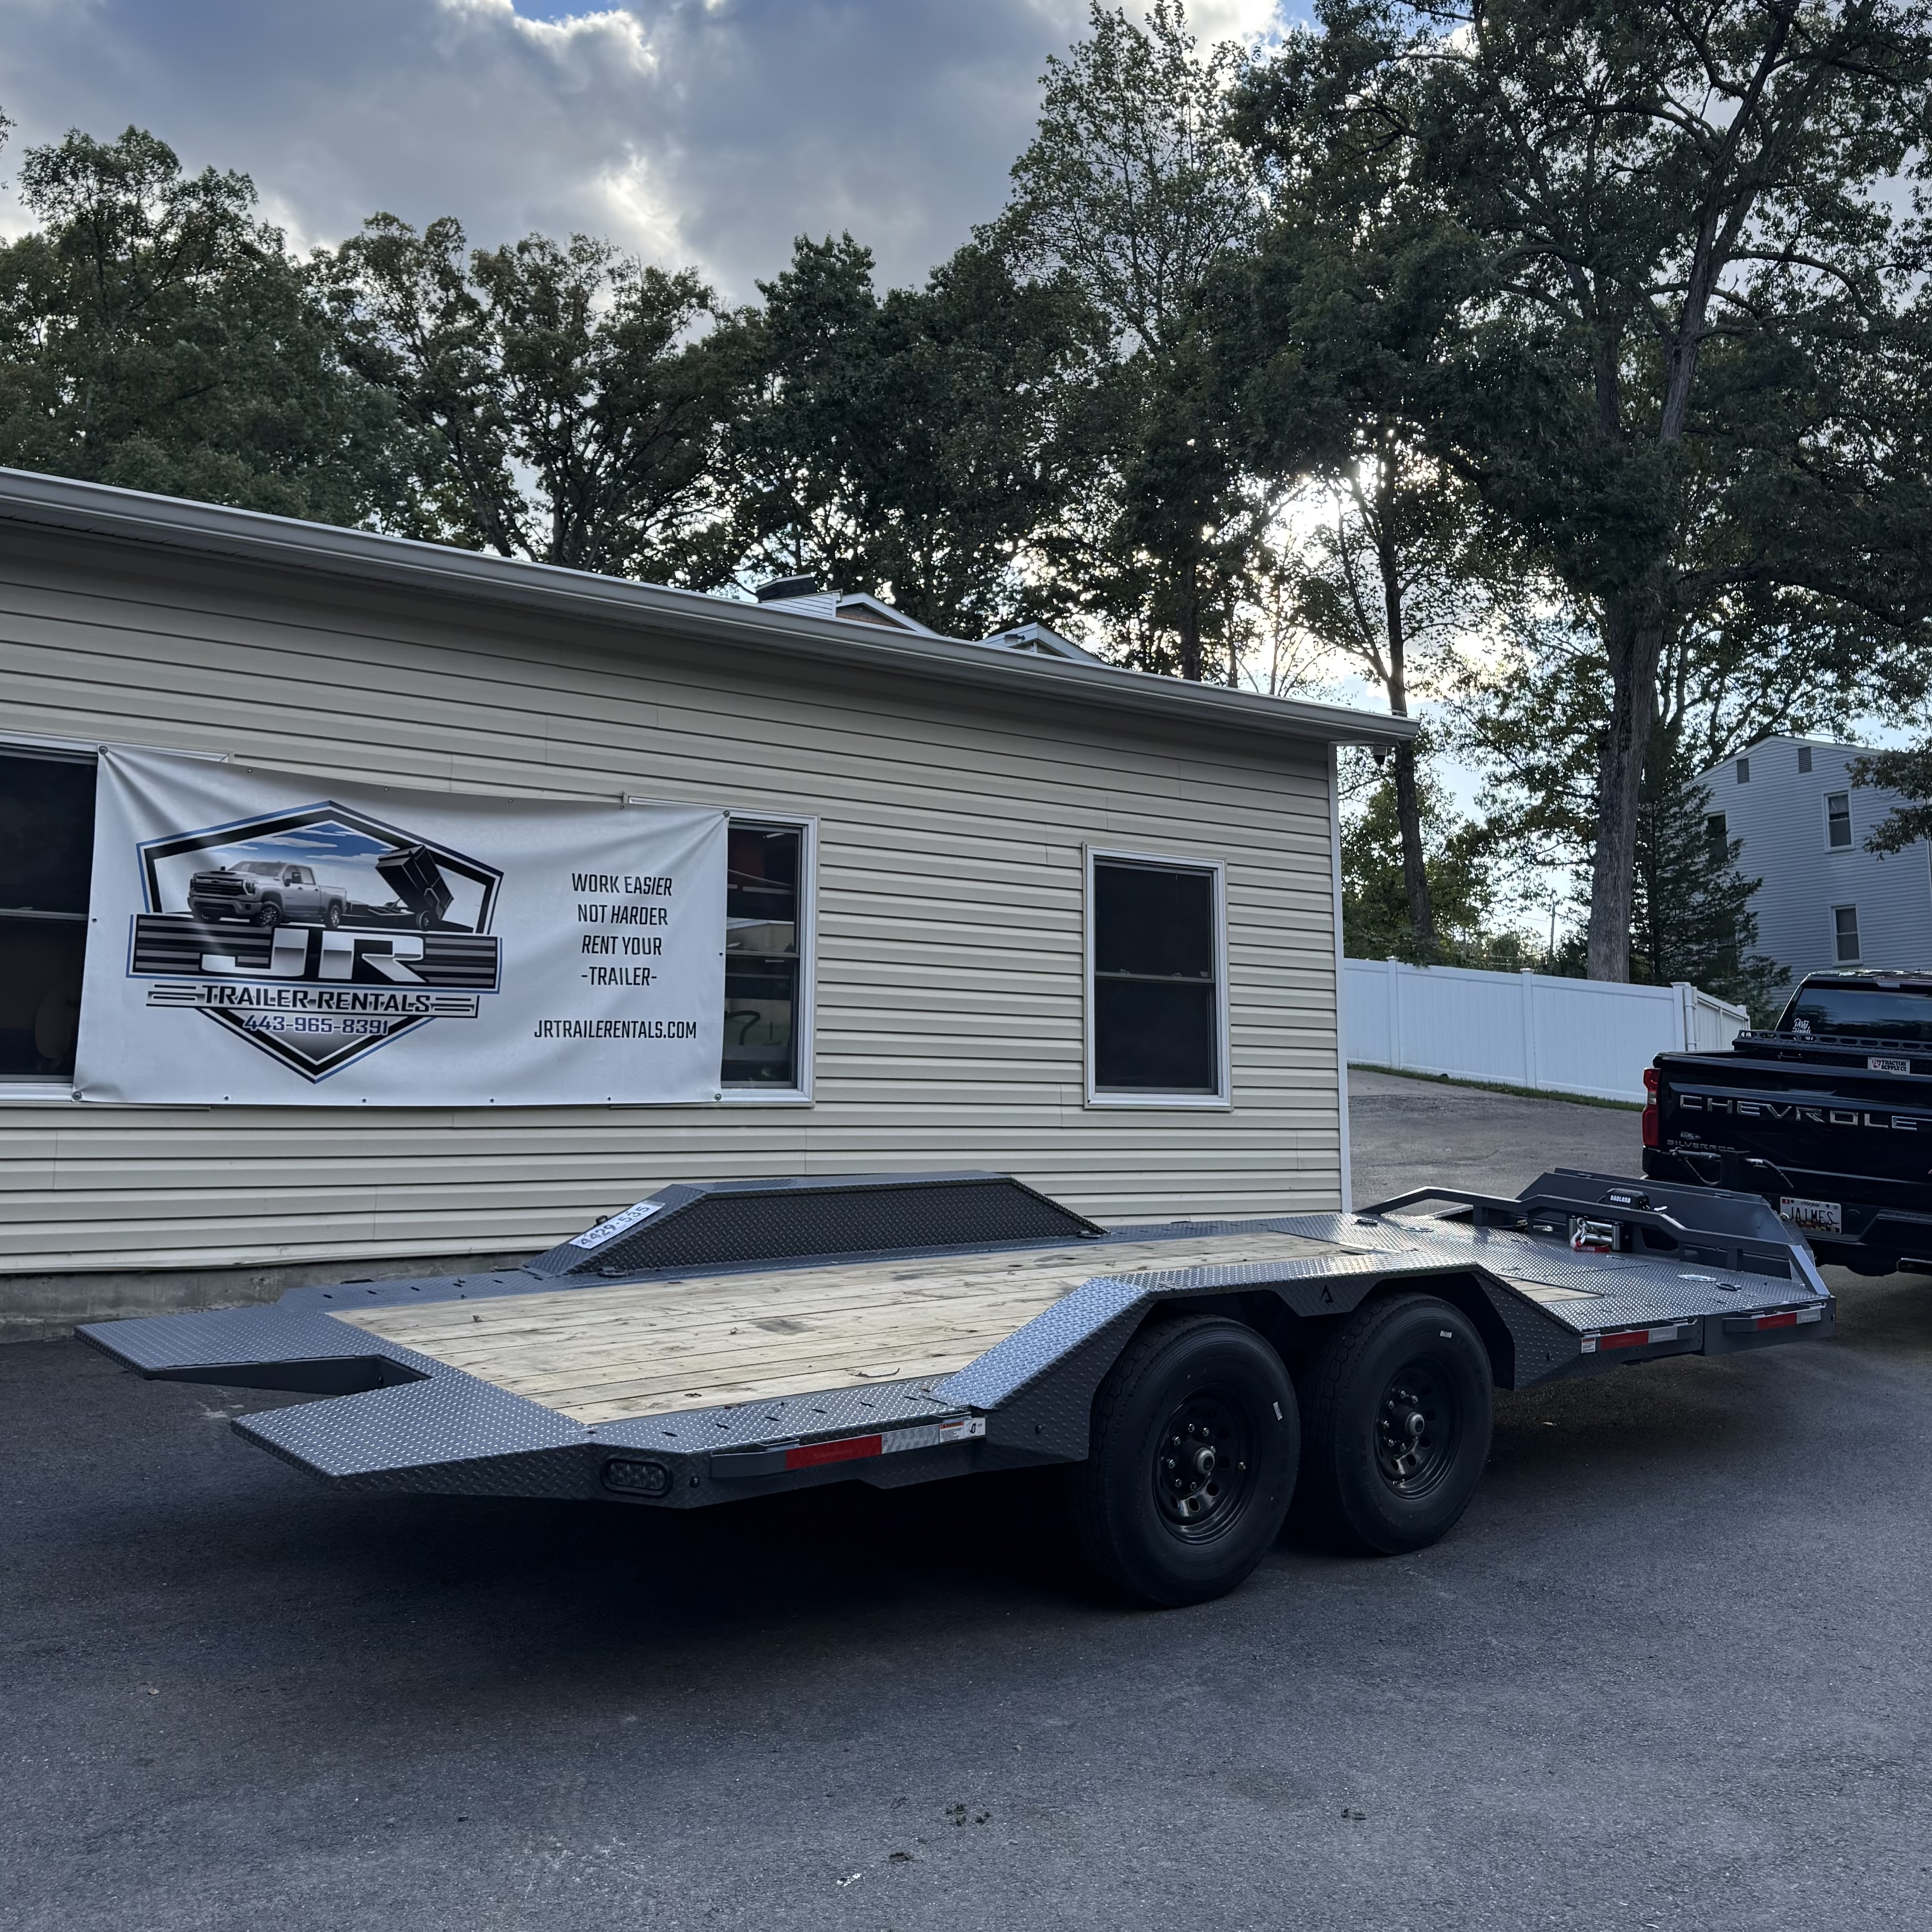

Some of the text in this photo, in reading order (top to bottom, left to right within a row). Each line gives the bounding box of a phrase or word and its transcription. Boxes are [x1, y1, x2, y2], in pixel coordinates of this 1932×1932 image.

[572, 873, 672, 896] WORK EASIER
[578, 904, 668, 925] NOT HARDER
[201, 927, 427, 983] JR
[581, 935, 662, 955] RENT YOUR
[581, 967, 657, 986] -TRAILER-
[202, 985, 431, 1012] TRAILER RENTALS
[244, 1014, 388, 1035] 443-965-8391
[534, 1020, 697, 1039] JRTRAILERENTALS.COM
[1679, 1094, 1932, 1132] CHEVROLE
